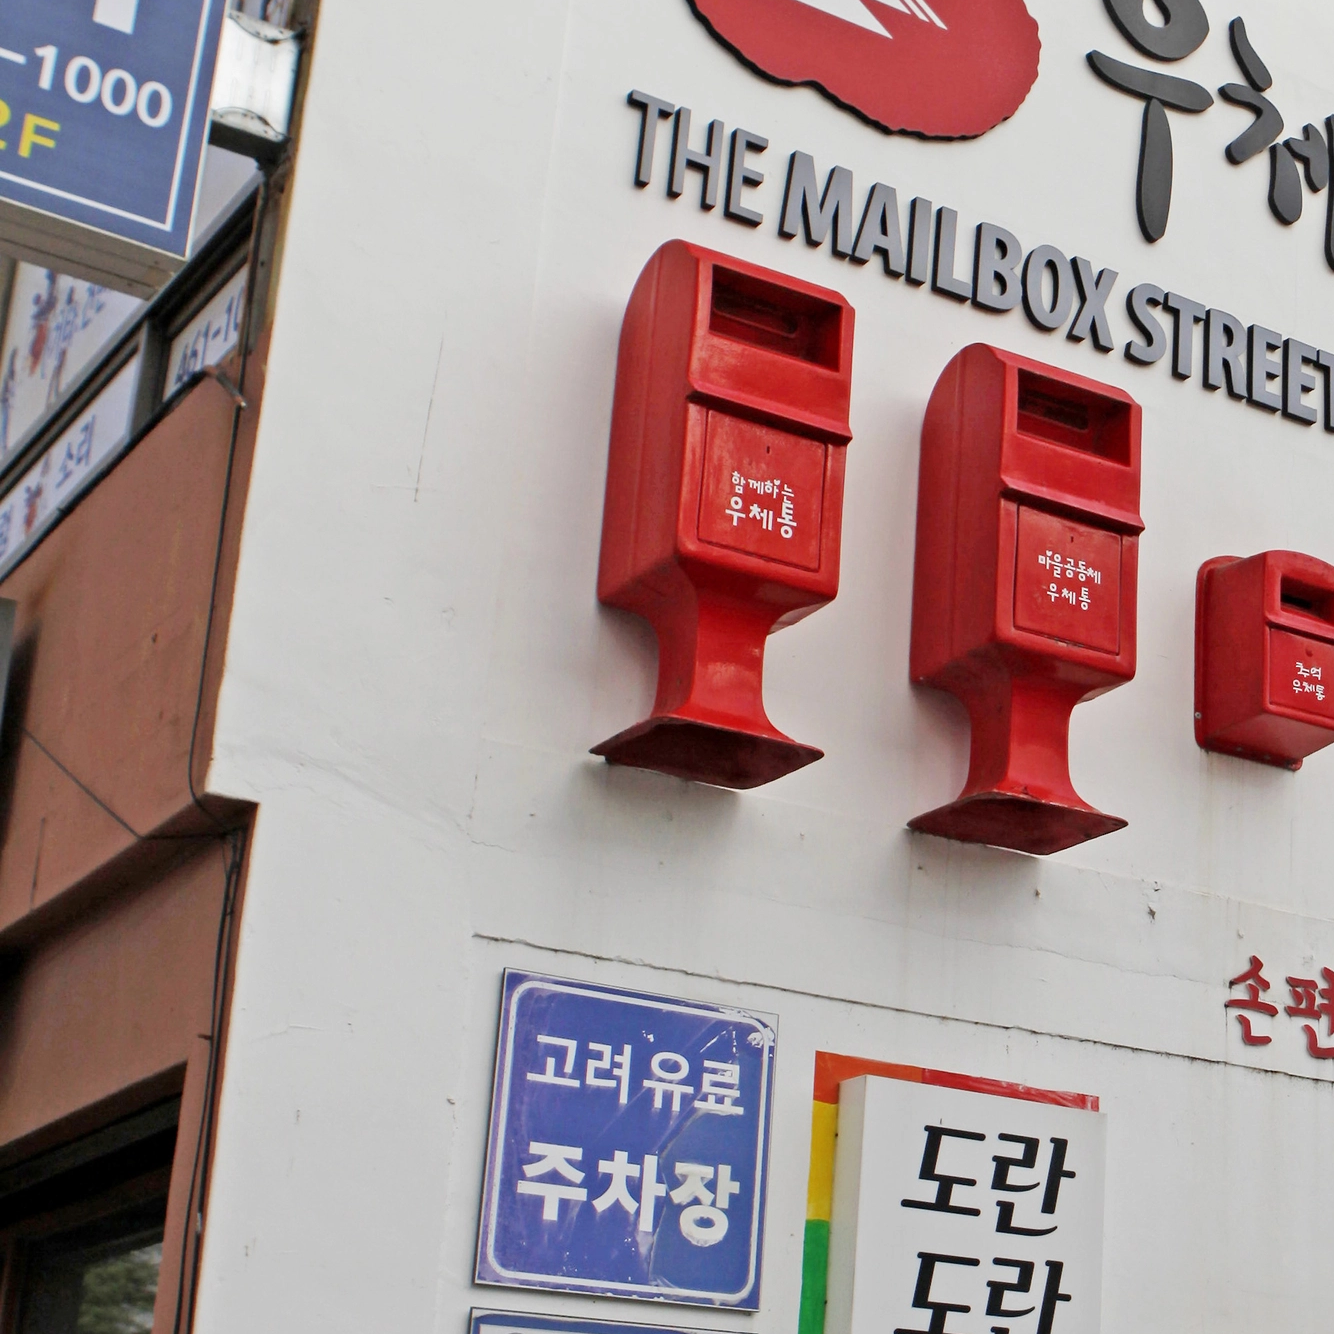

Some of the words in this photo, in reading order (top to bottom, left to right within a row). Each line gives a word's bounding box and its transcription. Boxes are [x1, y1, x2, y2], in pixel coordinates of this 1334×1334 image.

[627, 89, 769, 227] THE
[779, 149, 1119, 354] MAILBOX
[731, 470, 795, 504] 함께하는
[725, 496, 797, 539] 우체통
[1038, 550, 1101, 585] 마을공동체
[1046, 582, 1092, 611] 우체통
[1295, 661, 1322, 681] 추억
[1292, 679, 1326, 701] 우체통
[516, 1140, 741, 1248] 주차장
[901, 1124, 1076, 1237] 도란
